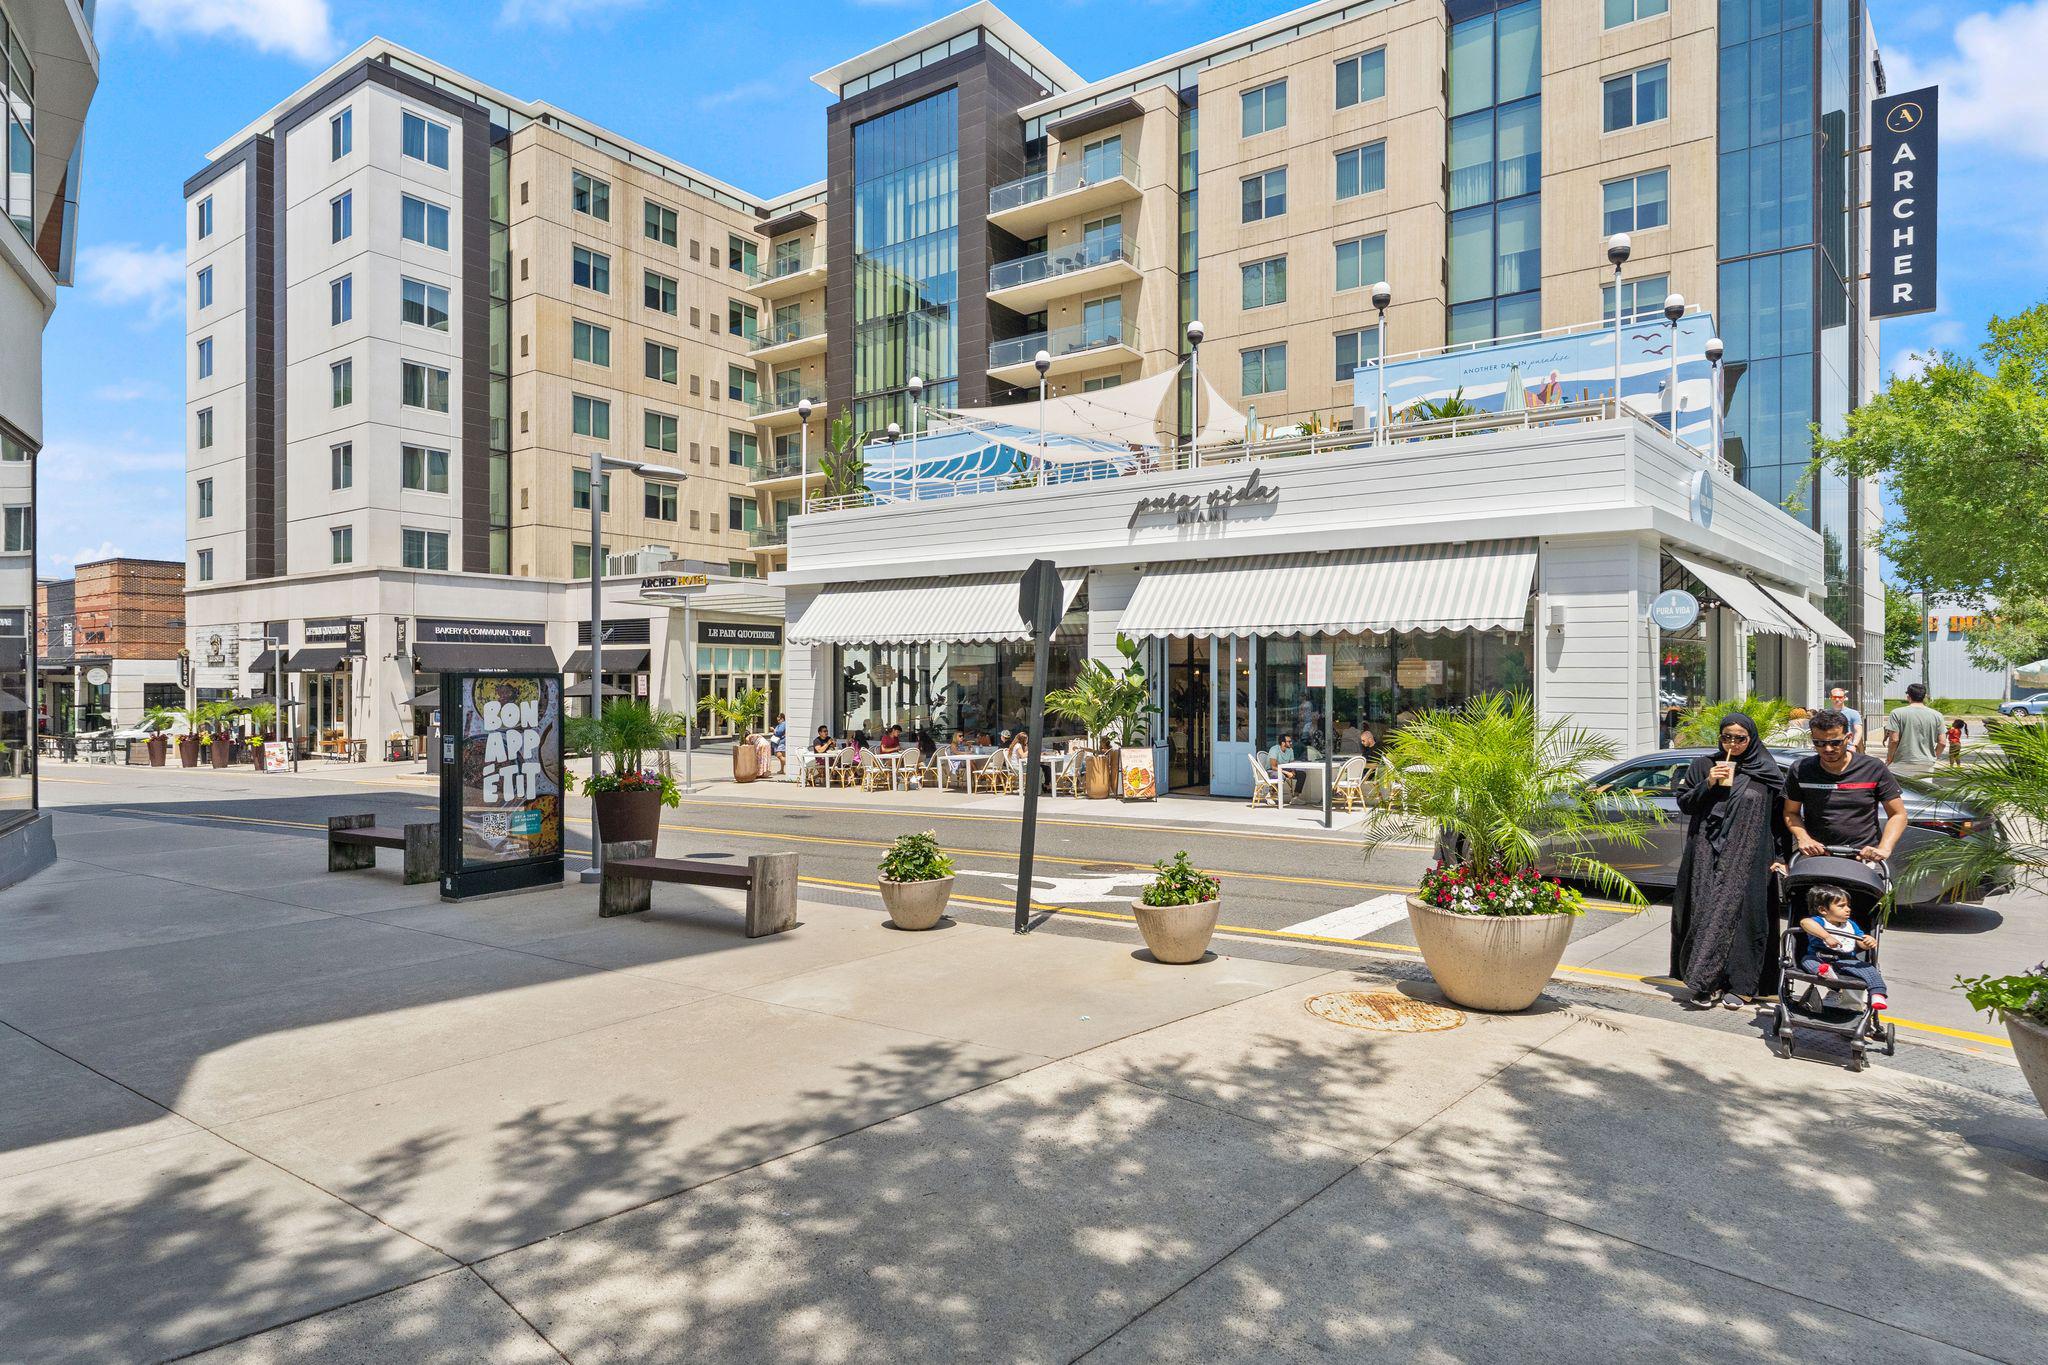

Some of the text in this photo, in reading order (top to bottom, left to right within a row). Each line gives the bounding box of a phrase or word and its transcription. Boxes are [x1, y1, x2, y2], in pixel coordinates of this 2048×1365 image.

[1891, 142, 1917, 304] ARCHER
[1463, 365, 1498, 375] ANOTHER
[1527, 352, 1569, 370] paradise
[1127, 467, 1280, 529] pura vida
[1176, 507, 1228, 525] MIAMI
[640, 574, 709, 589] ARCHER HOTEL
[1656, 605, 1691, 615] PURA VIDA
[435, 627, 462, 635] BAKERY
[470, 628, 510, 636] COMMUNAL
[511, 629, 532, 637] TABLE
[708, 628, 775, 640] LE PAIN QUOTIDIEN
[483, 700, 539, 731] BON
[485, 729, 541, 763] APP
